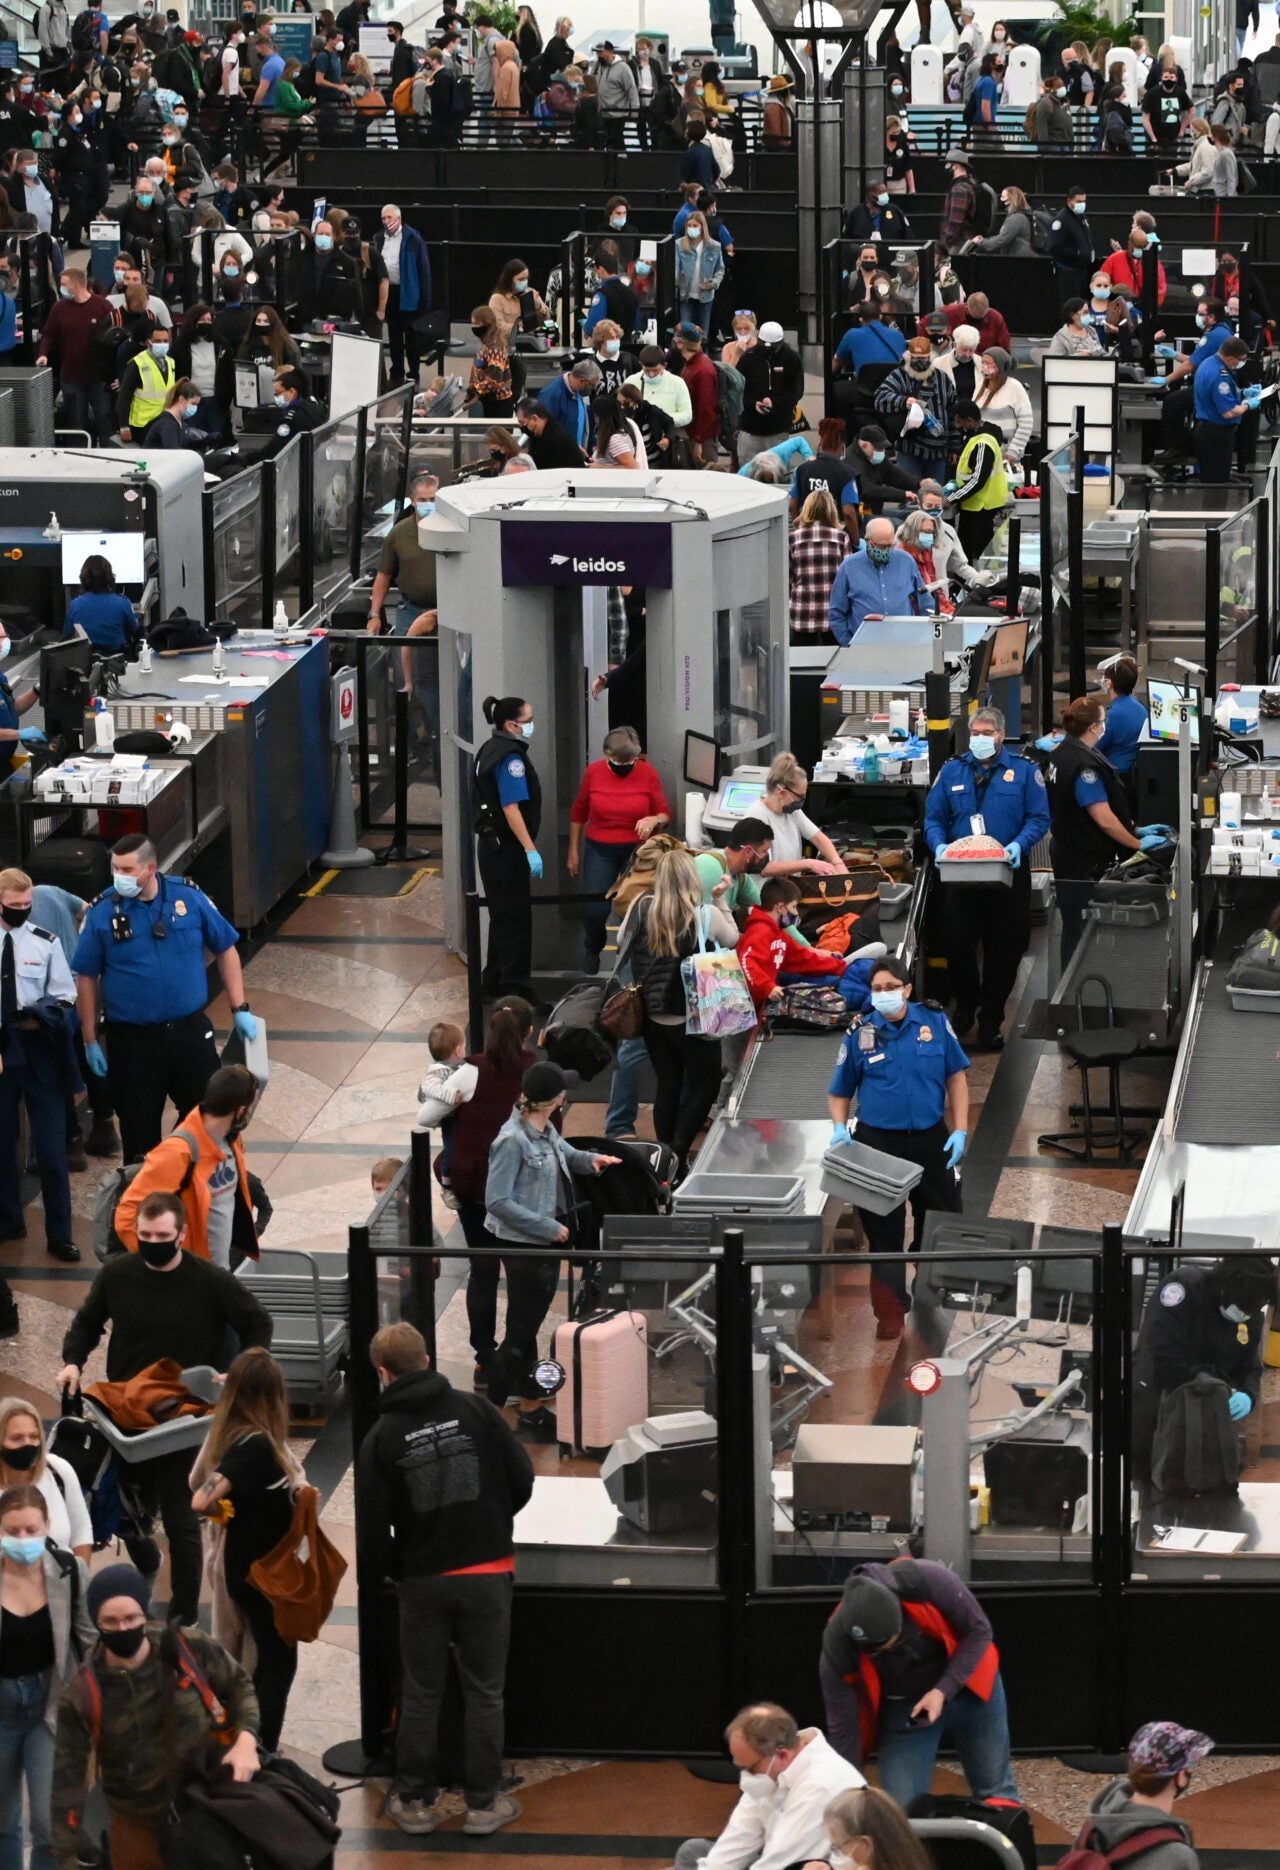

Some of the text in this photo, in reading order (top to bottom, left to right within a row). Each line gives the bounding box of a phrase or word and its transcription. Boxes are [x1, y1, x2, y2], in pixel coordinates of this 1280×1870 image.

[0, 111, 11, 120] SA
[808, 478, 830, 492] TSA
[573, 557, 626, 572] leidos
[934, 623, 941, 639] 5
[1180, 707, 1188, 723] 6
